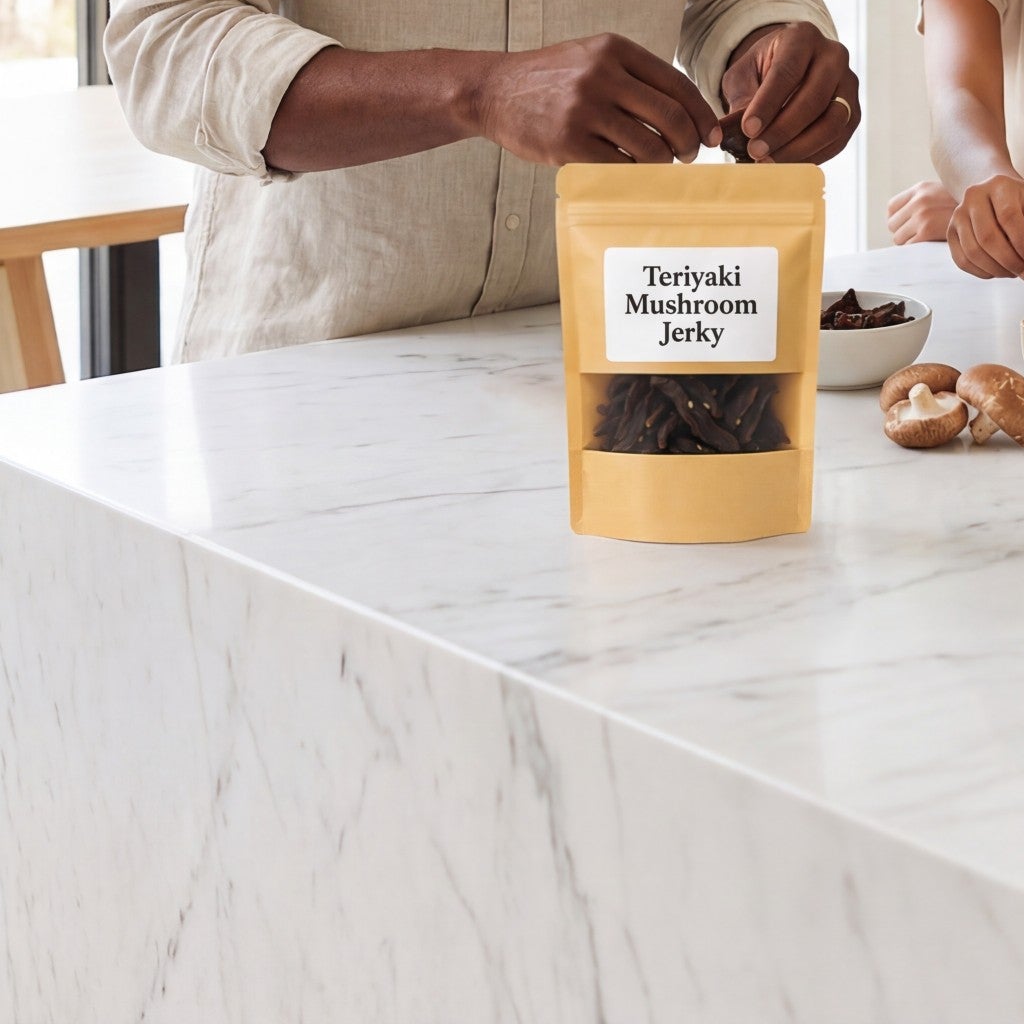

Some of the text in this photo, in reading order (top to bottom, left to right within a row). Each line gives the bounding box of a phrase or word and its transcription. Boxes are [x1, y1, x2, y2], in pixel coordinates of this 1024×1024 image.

[642, 264, 742, 293] Teriyaki
[624, 292, 758, 315] Mushroom
[658, 320, 725, 348] Jerky
